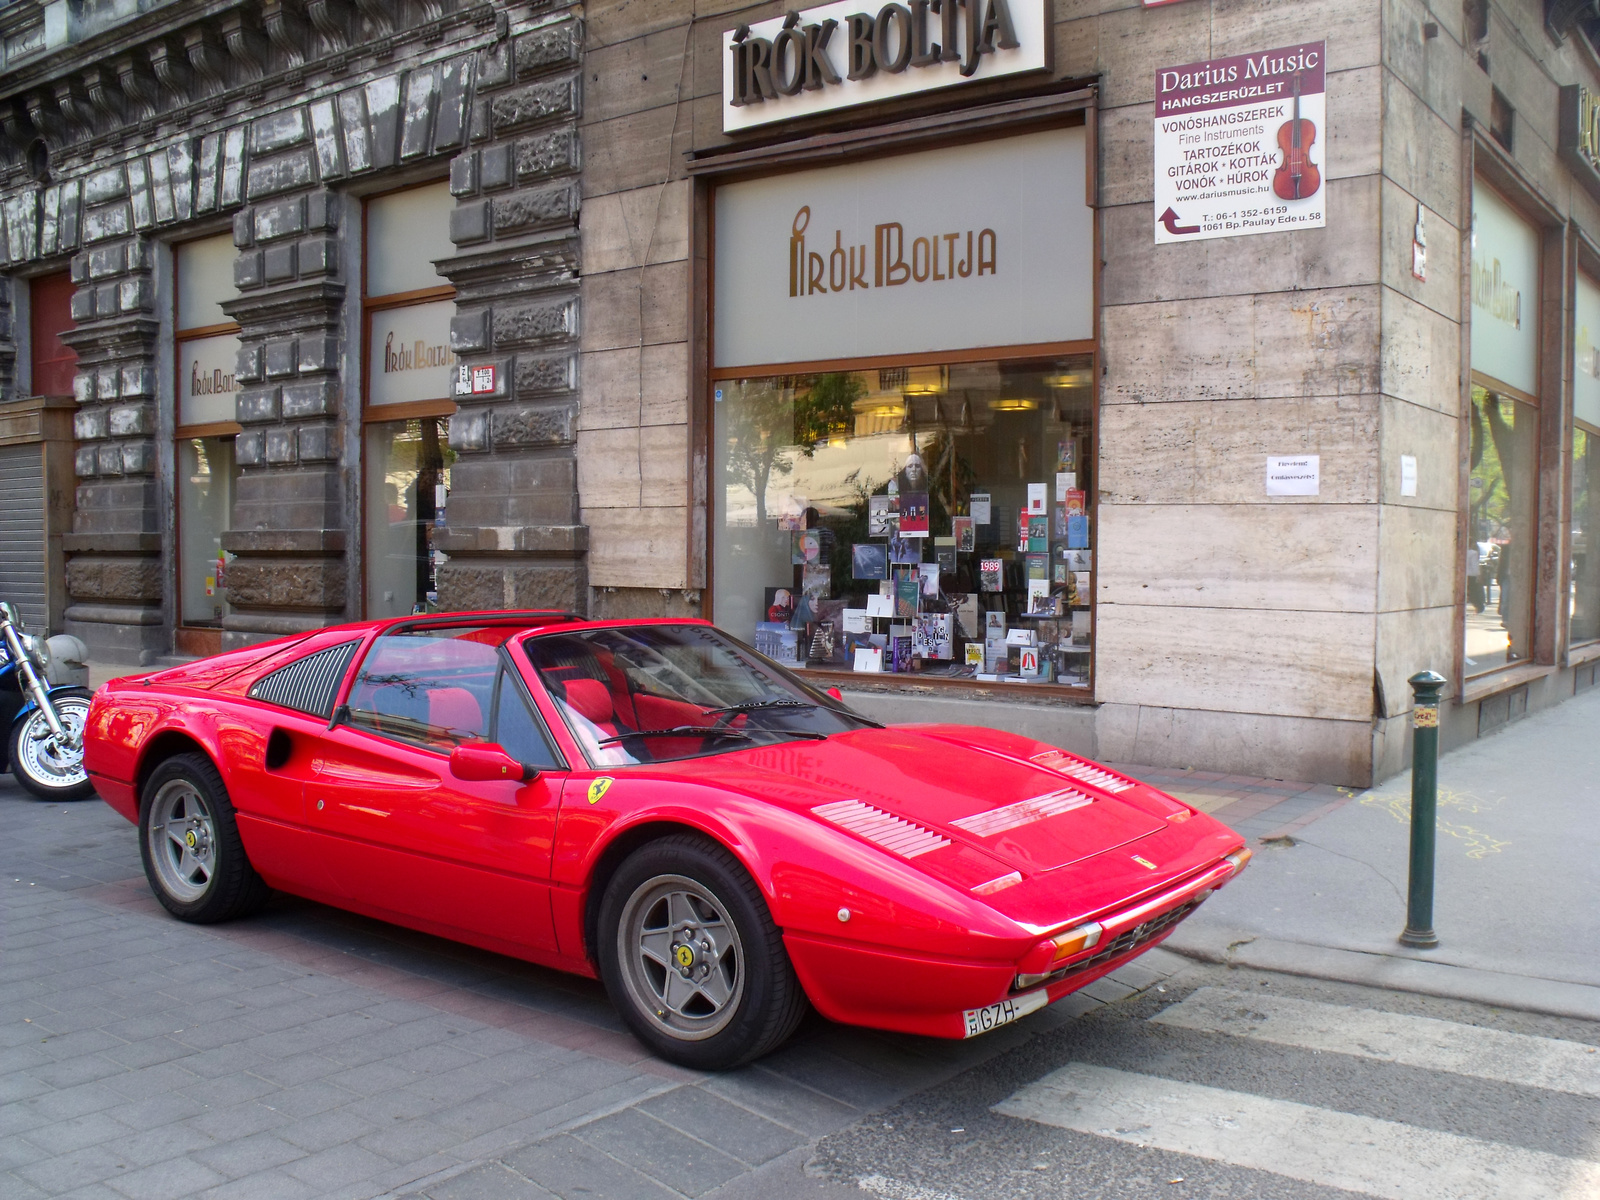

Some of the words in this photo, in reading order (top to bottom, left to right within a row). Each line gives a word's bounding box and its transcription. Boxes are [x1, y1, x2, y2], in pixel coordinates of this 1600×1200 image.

[729, 10, 842, 107] ÍRÓK
[845, 0, 1021, 81] BOLTJA
[1161, 64, 1238, 93] Darius
[1245, 48, 1319, 79] Music
[1162, 82, 1284, 110] HANGSZERÜZLET
[1162, 105, 1284, 133] VONÓSHANGSZEREK
[1179, 131, 1201, 145] Fine
[1204, 124, 1264, 142] Instruments
[1184, 141, 1260, 161] TARTOZÉKOK
[1168, 161, 1218, 178] GITÁROK
[1229, 153, 1277, 170] KOTTÁK
[1176, 175, 1216, 191] VONÓK
[1227, 169, 1269, 185] HÚROK
[1176, 185, 1270, 202] www.dariusmusic.hu
[1202, 222, 1223, 232] 1061
[1225, 221, 1241, 231] Bp.
[1242, 217, 1276, 229] Paulay
[1278, 214, 1297, 224] Ede
[1309, 212, 1321, 221] 58
[1216, 211, 1237, 221] 06-1
[1241, 206, 1288, 218] 352-6159
[789, 204, 869, 298] ÍRÓK
[875, 222, 996, 287] BOLTJA
[981, 562, 1000, 571] 1989
